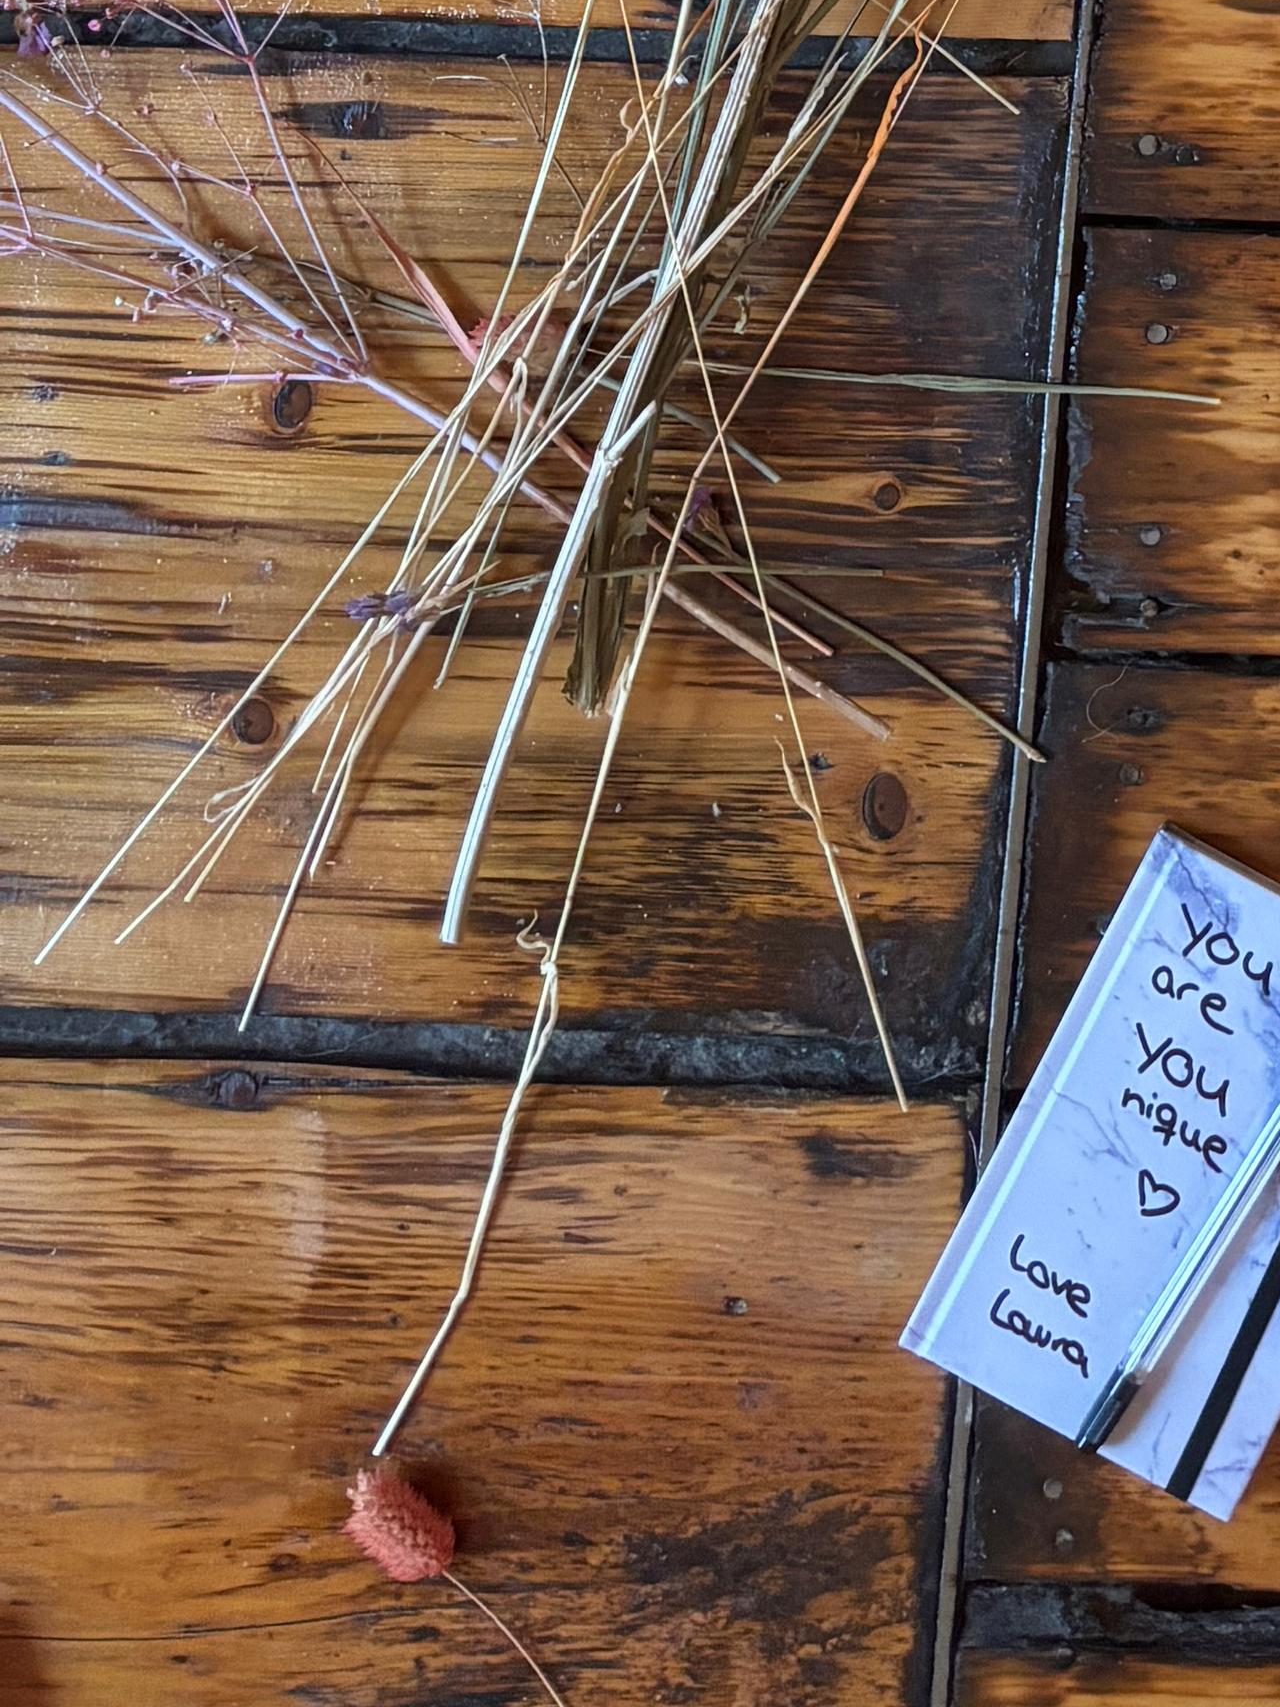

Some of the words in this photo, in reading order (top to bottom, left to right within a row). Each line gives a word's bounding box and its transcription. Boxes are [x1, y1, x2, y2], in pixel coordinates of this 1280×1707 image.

[1151, 966, 1234, 1035] are
[1121, 1087, 1229, 1174] nique
[1010, 1234, 1092, 1318] Love
[990, 1289, 1089, 1379] Laura
